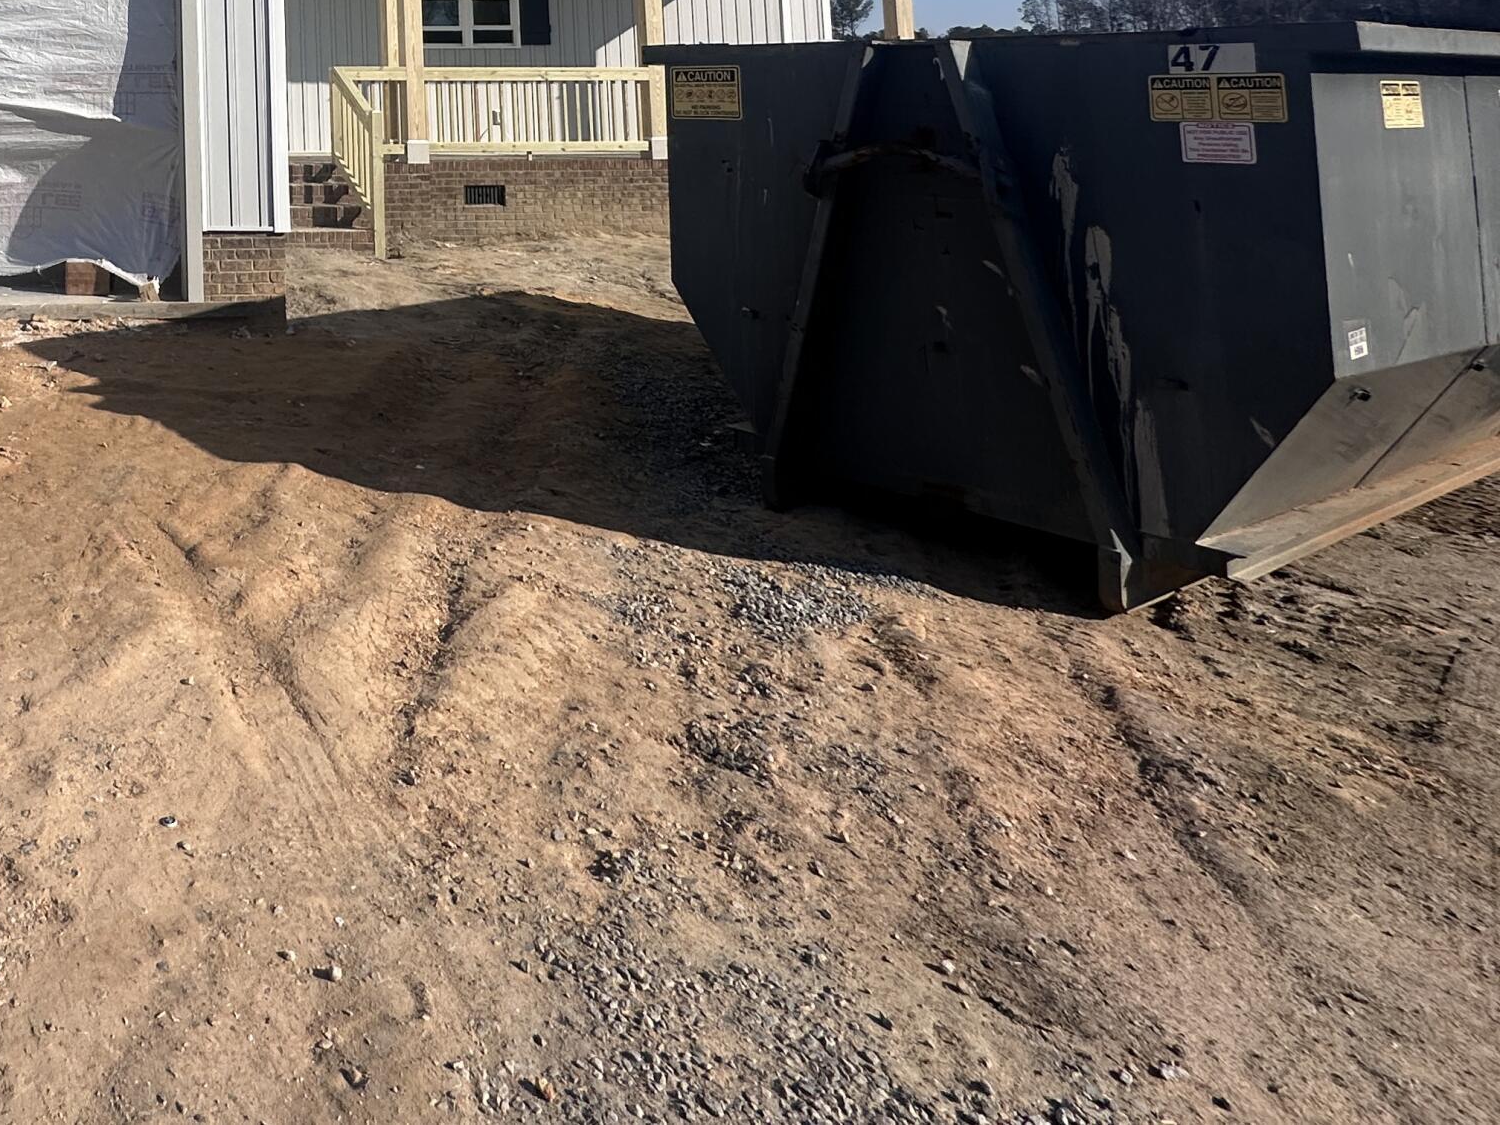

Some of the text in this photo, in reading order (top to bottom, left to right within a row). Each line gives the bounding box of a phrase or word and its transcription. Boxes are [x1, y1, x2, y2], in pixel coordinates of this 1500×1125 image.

[1170, 45, 1220, 72] 47
[687, 71, 731, 82] CAUTION
[1163, 79, 1210, 89] CAUTION
[1230, 78, 1280, 88] CAUTION
